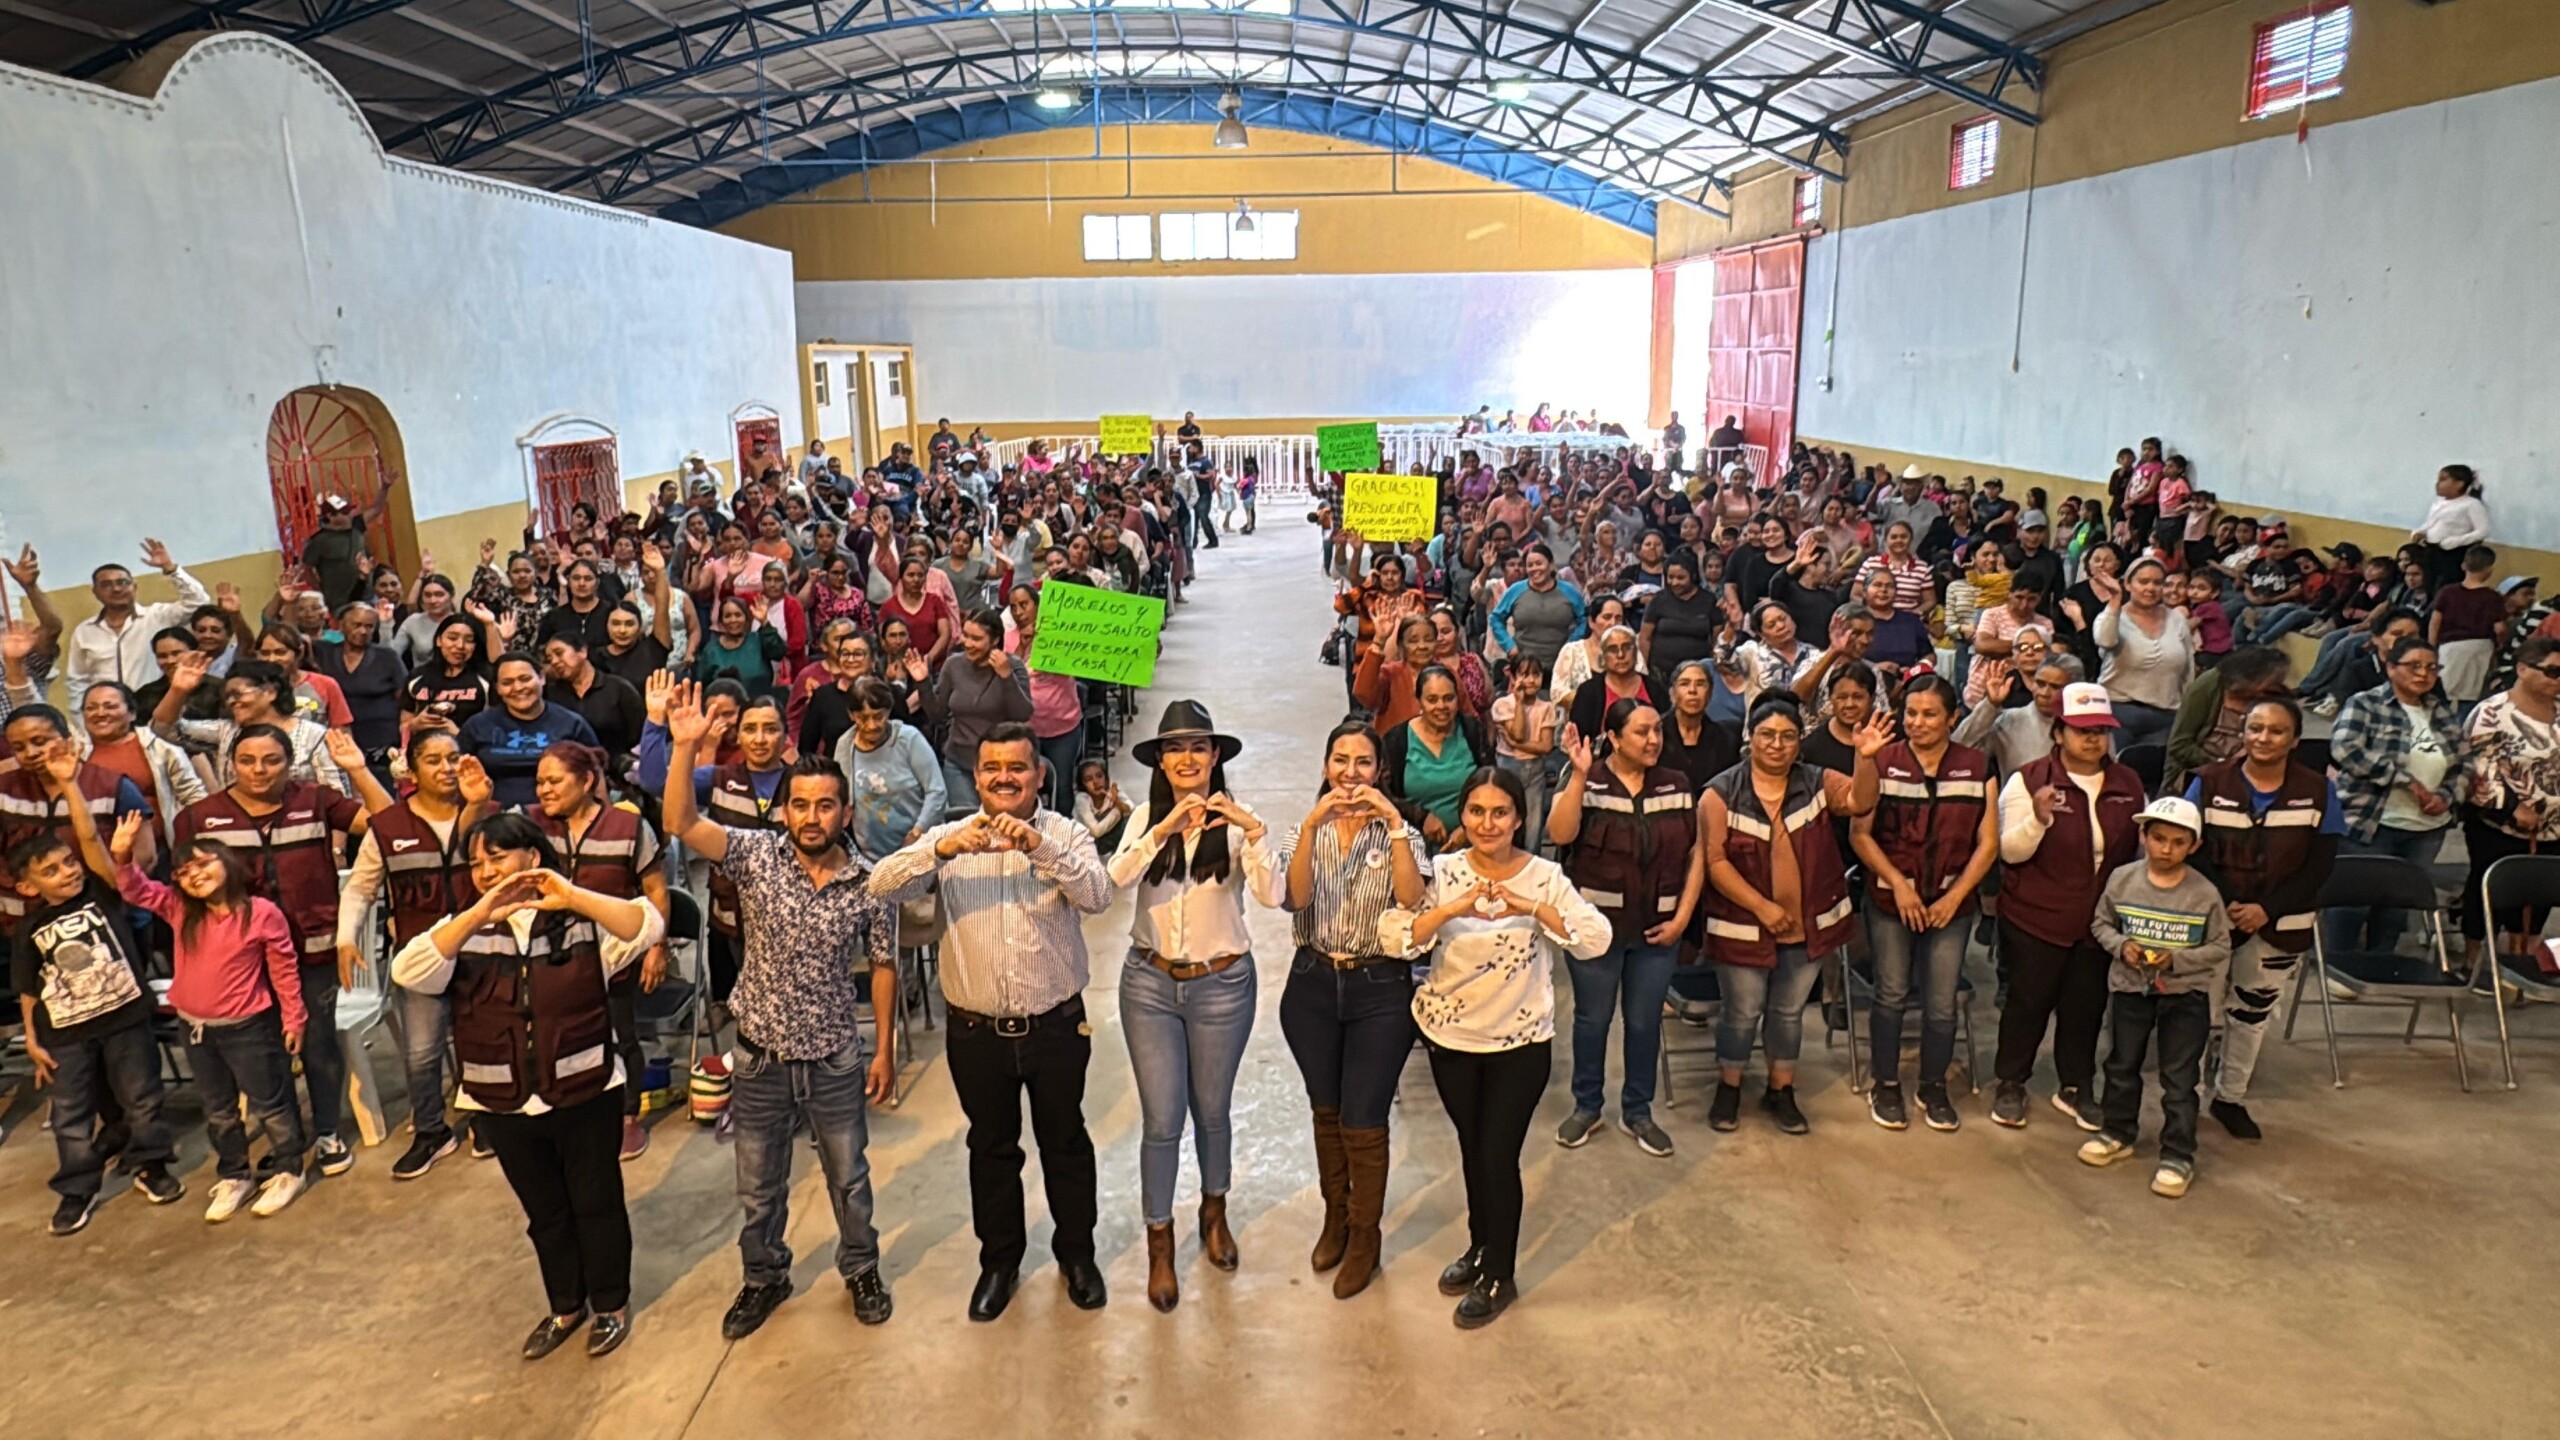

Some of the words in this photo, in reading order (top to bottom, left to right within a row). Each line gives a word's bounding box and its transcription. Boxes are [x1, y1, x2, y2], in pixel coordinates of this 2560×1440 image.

[1346, 500, 1421, 514] PRESIDENTA
[1047, 588, 1128, 617] MORELOS
[1038, 615, 1098, 634] ESPIRITU
[1100, 622, 1152, 638] SANTO
[1036, 637, 1100, 657] SIEMPRE
[1040, 654, 1057, 667] TU
[35, 909, 104, 955] NASA
[2127, 917, 2146, 928] THE
[2148, 920, 2190, 933] FUTURE
[2164, 931, 2189, 942] NOW
